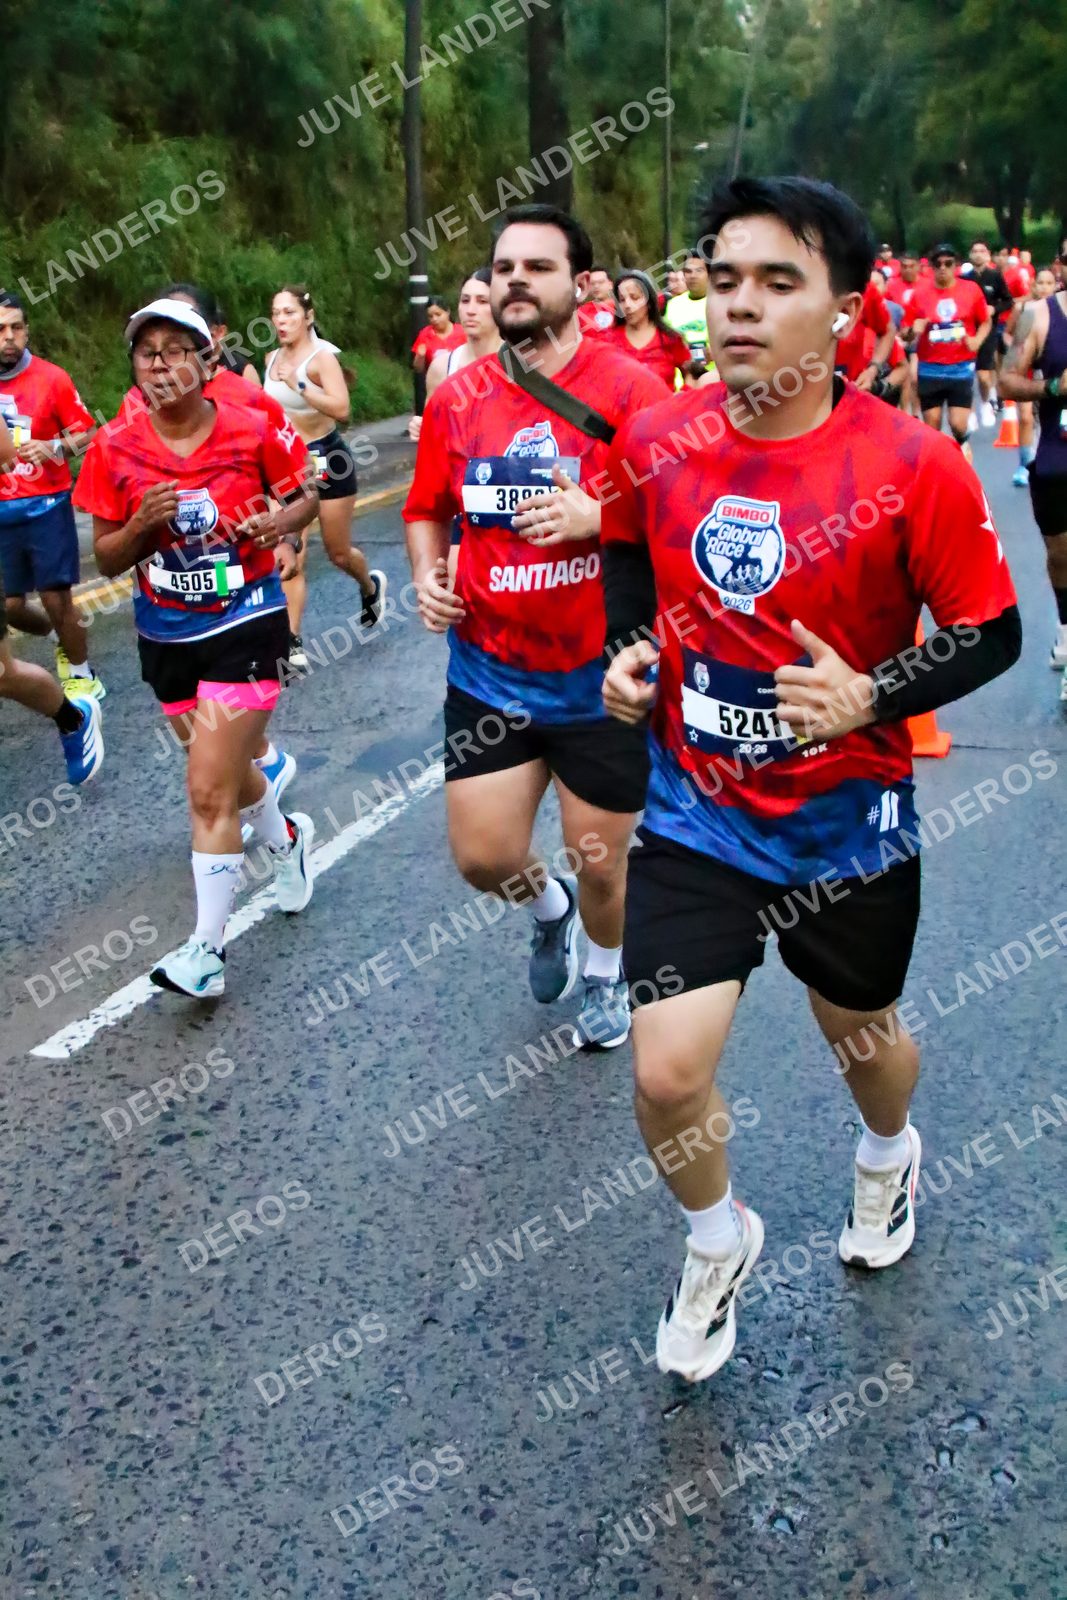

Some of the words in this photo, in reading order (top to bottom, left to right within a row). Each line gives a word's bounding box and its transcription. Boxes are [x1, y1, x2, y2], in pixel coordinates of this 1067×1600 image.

[496, 488, 545, 511] 38
[722, 505, 770, 523] BIMBO
[717, 524, 766, 547] Global
[705, 537, 745, 559] Race
[171, 571, 214, 592] 4505
[489, 553, 600, 592] SANTIAGO
[723, 596, 752, 611] 2026
[718, 704, 782, 739] 5241
[739, 743, 768, 754] 20-26
[802, 743, 828, 758] 10K
